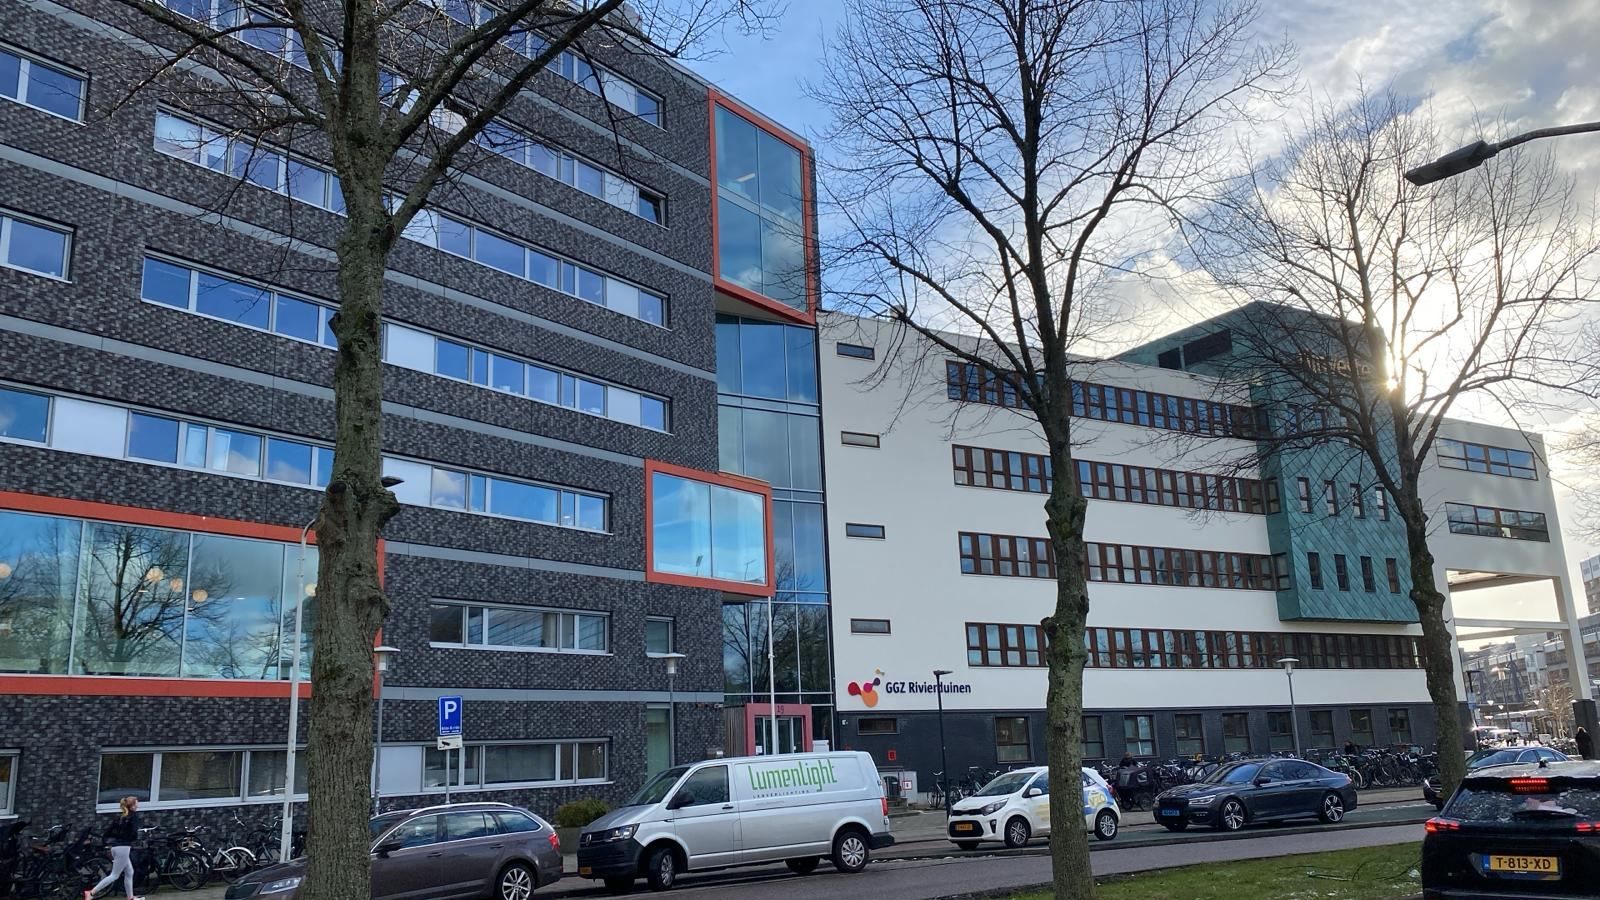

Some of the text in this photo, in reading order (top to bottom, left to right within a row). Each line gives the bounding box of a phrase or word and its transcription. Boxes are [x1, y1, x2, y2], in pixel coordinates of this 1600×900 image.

[885, 681, 971, 694] GGZ Rivierduinen
[444, 700, 457, 720] P
[1496, 857, 1551, 870] T-813-XD
